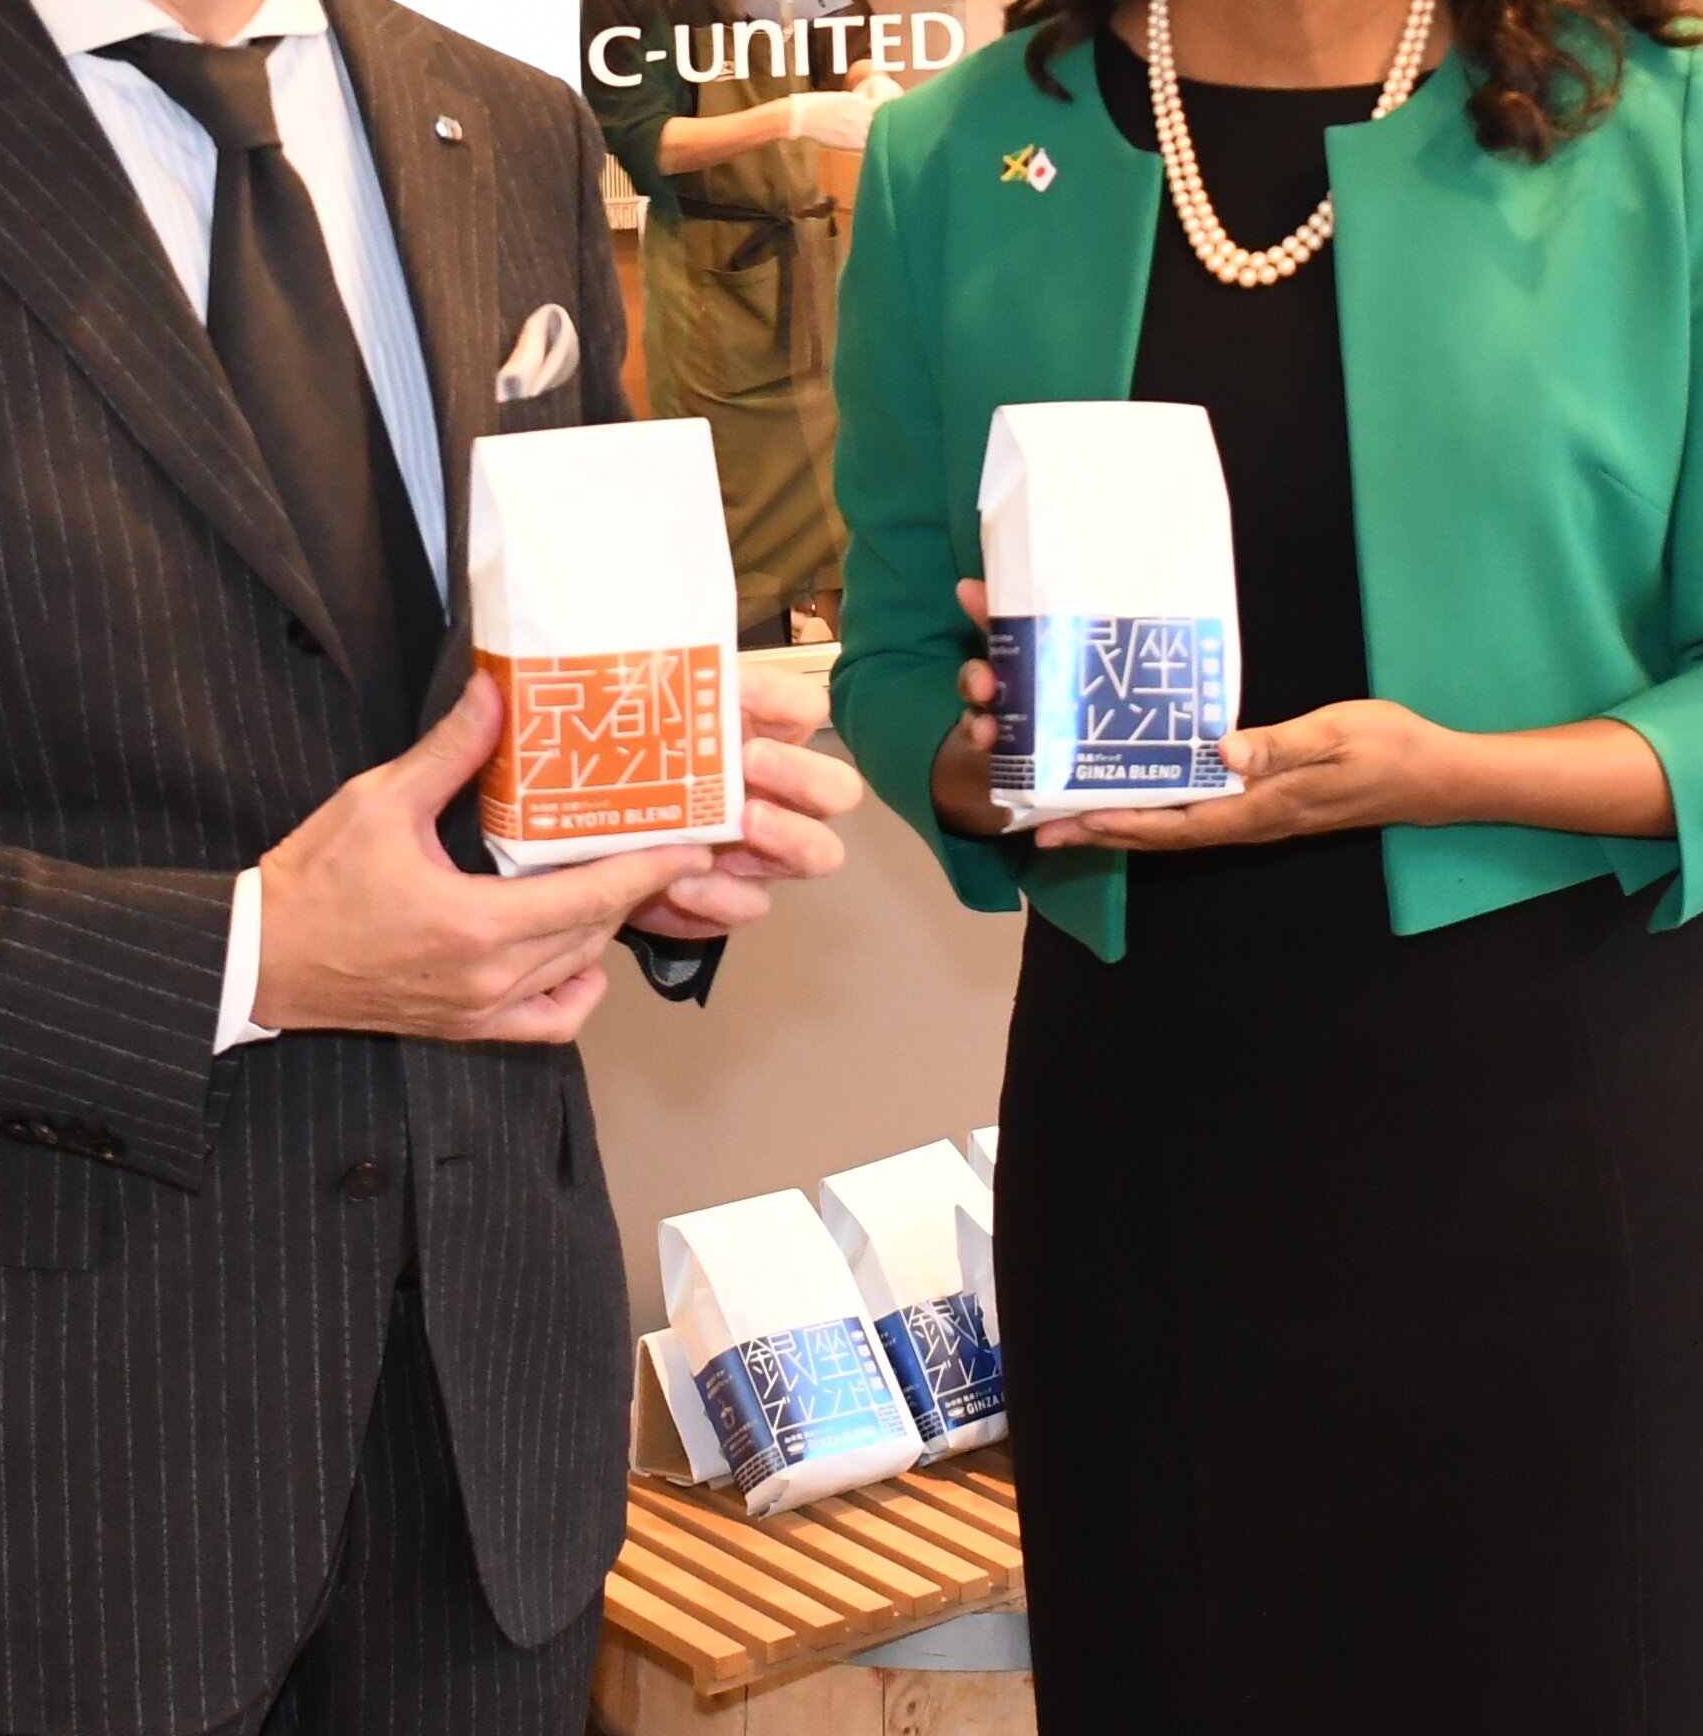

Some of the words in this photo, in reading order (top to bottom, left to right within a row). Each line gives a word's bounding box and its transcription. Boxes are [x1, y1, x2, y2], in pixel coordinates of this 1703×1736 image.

[517, 650, 684, 743] 京都
[1068, 701, 1194, 742] レンド
[517, 740, 686, 792] ブレンド
[1076, 764, 1126, 780] GINZA
[1129, 763, 1182, 780] BLEND
[560, 810, 621, 830] KYOTO
[624, 804, 683, 825] BLEND
[745, 1321, 861, 1400] 銀座
